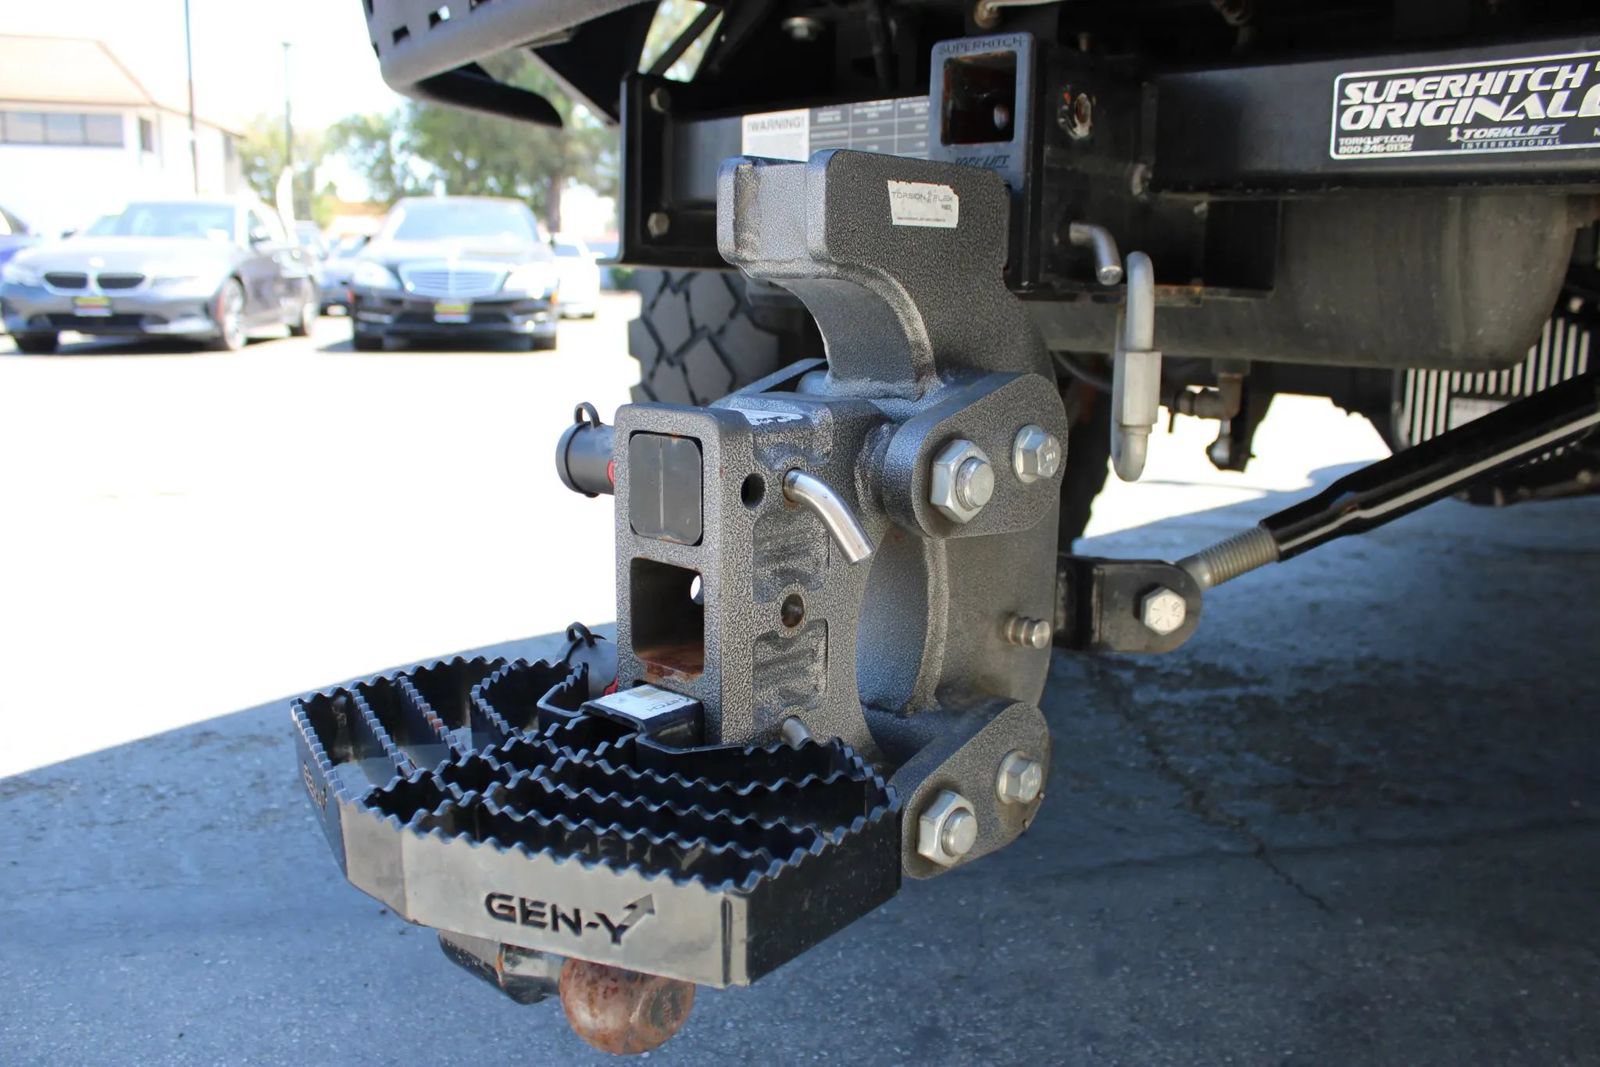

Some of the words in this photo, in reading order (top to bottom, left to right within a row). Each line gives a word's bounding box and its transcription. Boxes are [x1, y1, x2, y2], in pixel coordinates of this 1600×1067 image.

[938, 36, 1022, 54] SUPERHITCH
[1340, 63, 1590, 105] SUPERHITCH
[1340, 89, 1578, 131] ORIGINAL
[1339, 134, 1415, 146] TORKLIFT.COM
[1463, 123, 1566, 139] TORKLIFT
[1461, 138, 1561, 150] INTERNATIONAL
[485, 891, 646, 945] GEN-Y
